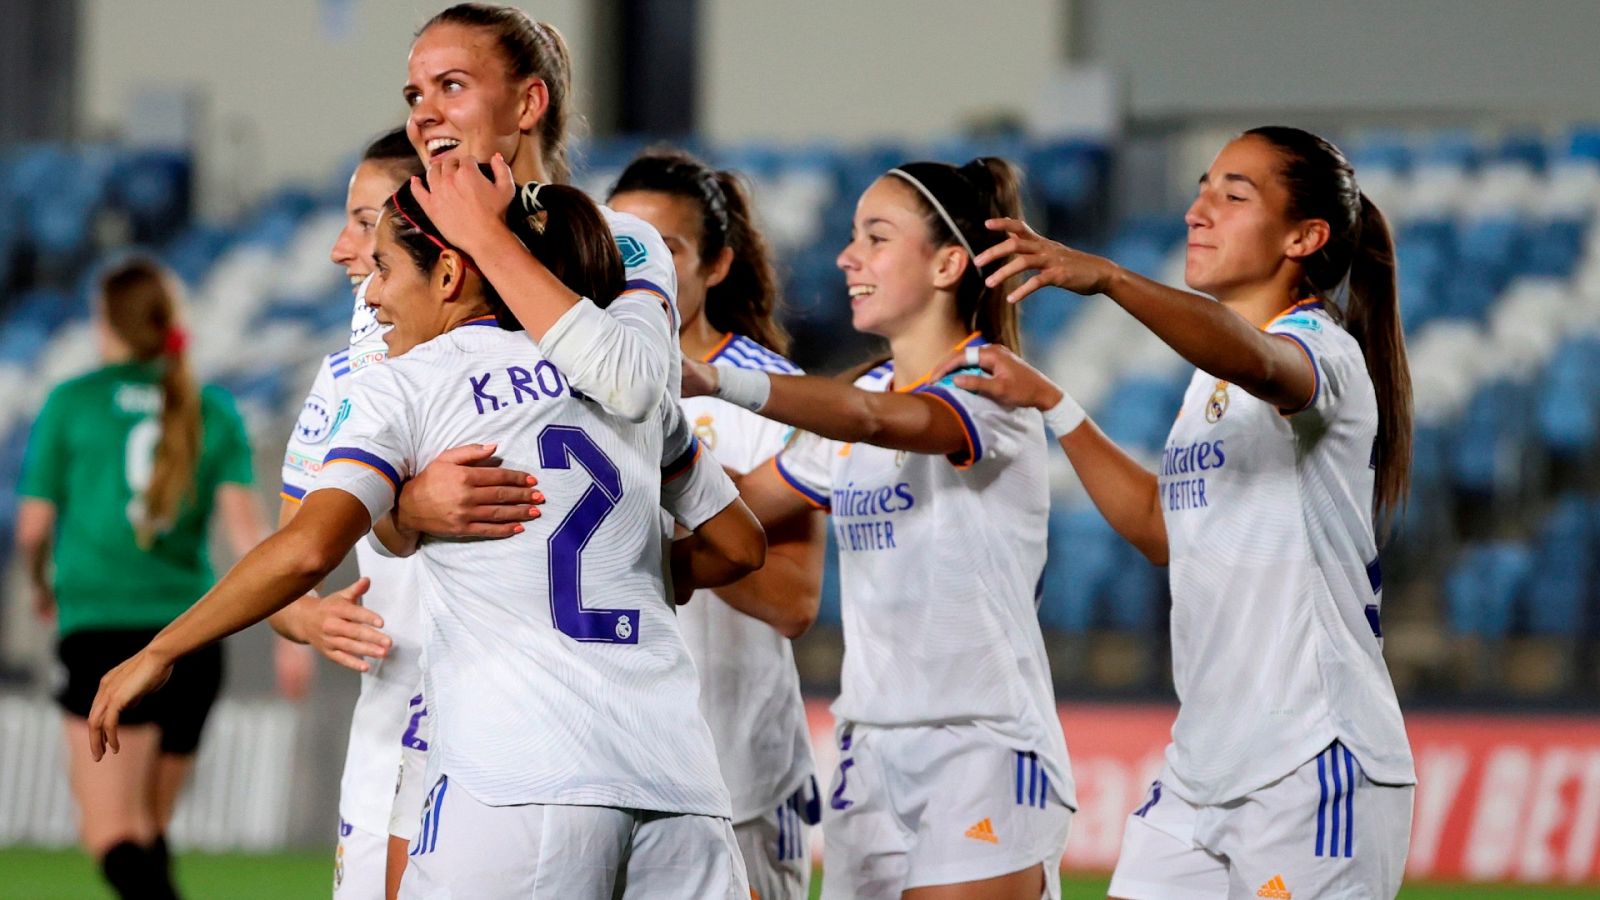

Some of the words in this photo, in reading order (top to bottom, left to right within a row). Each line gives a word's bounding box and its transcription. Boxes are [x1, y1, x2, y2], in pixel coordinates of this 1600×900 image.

[469, 359, 601, 415] K.RO
[1169, 478, 1208, 511] BETTER
[537, 424, 640, 644] 2
[848, 521, 896, 551] BETTER
